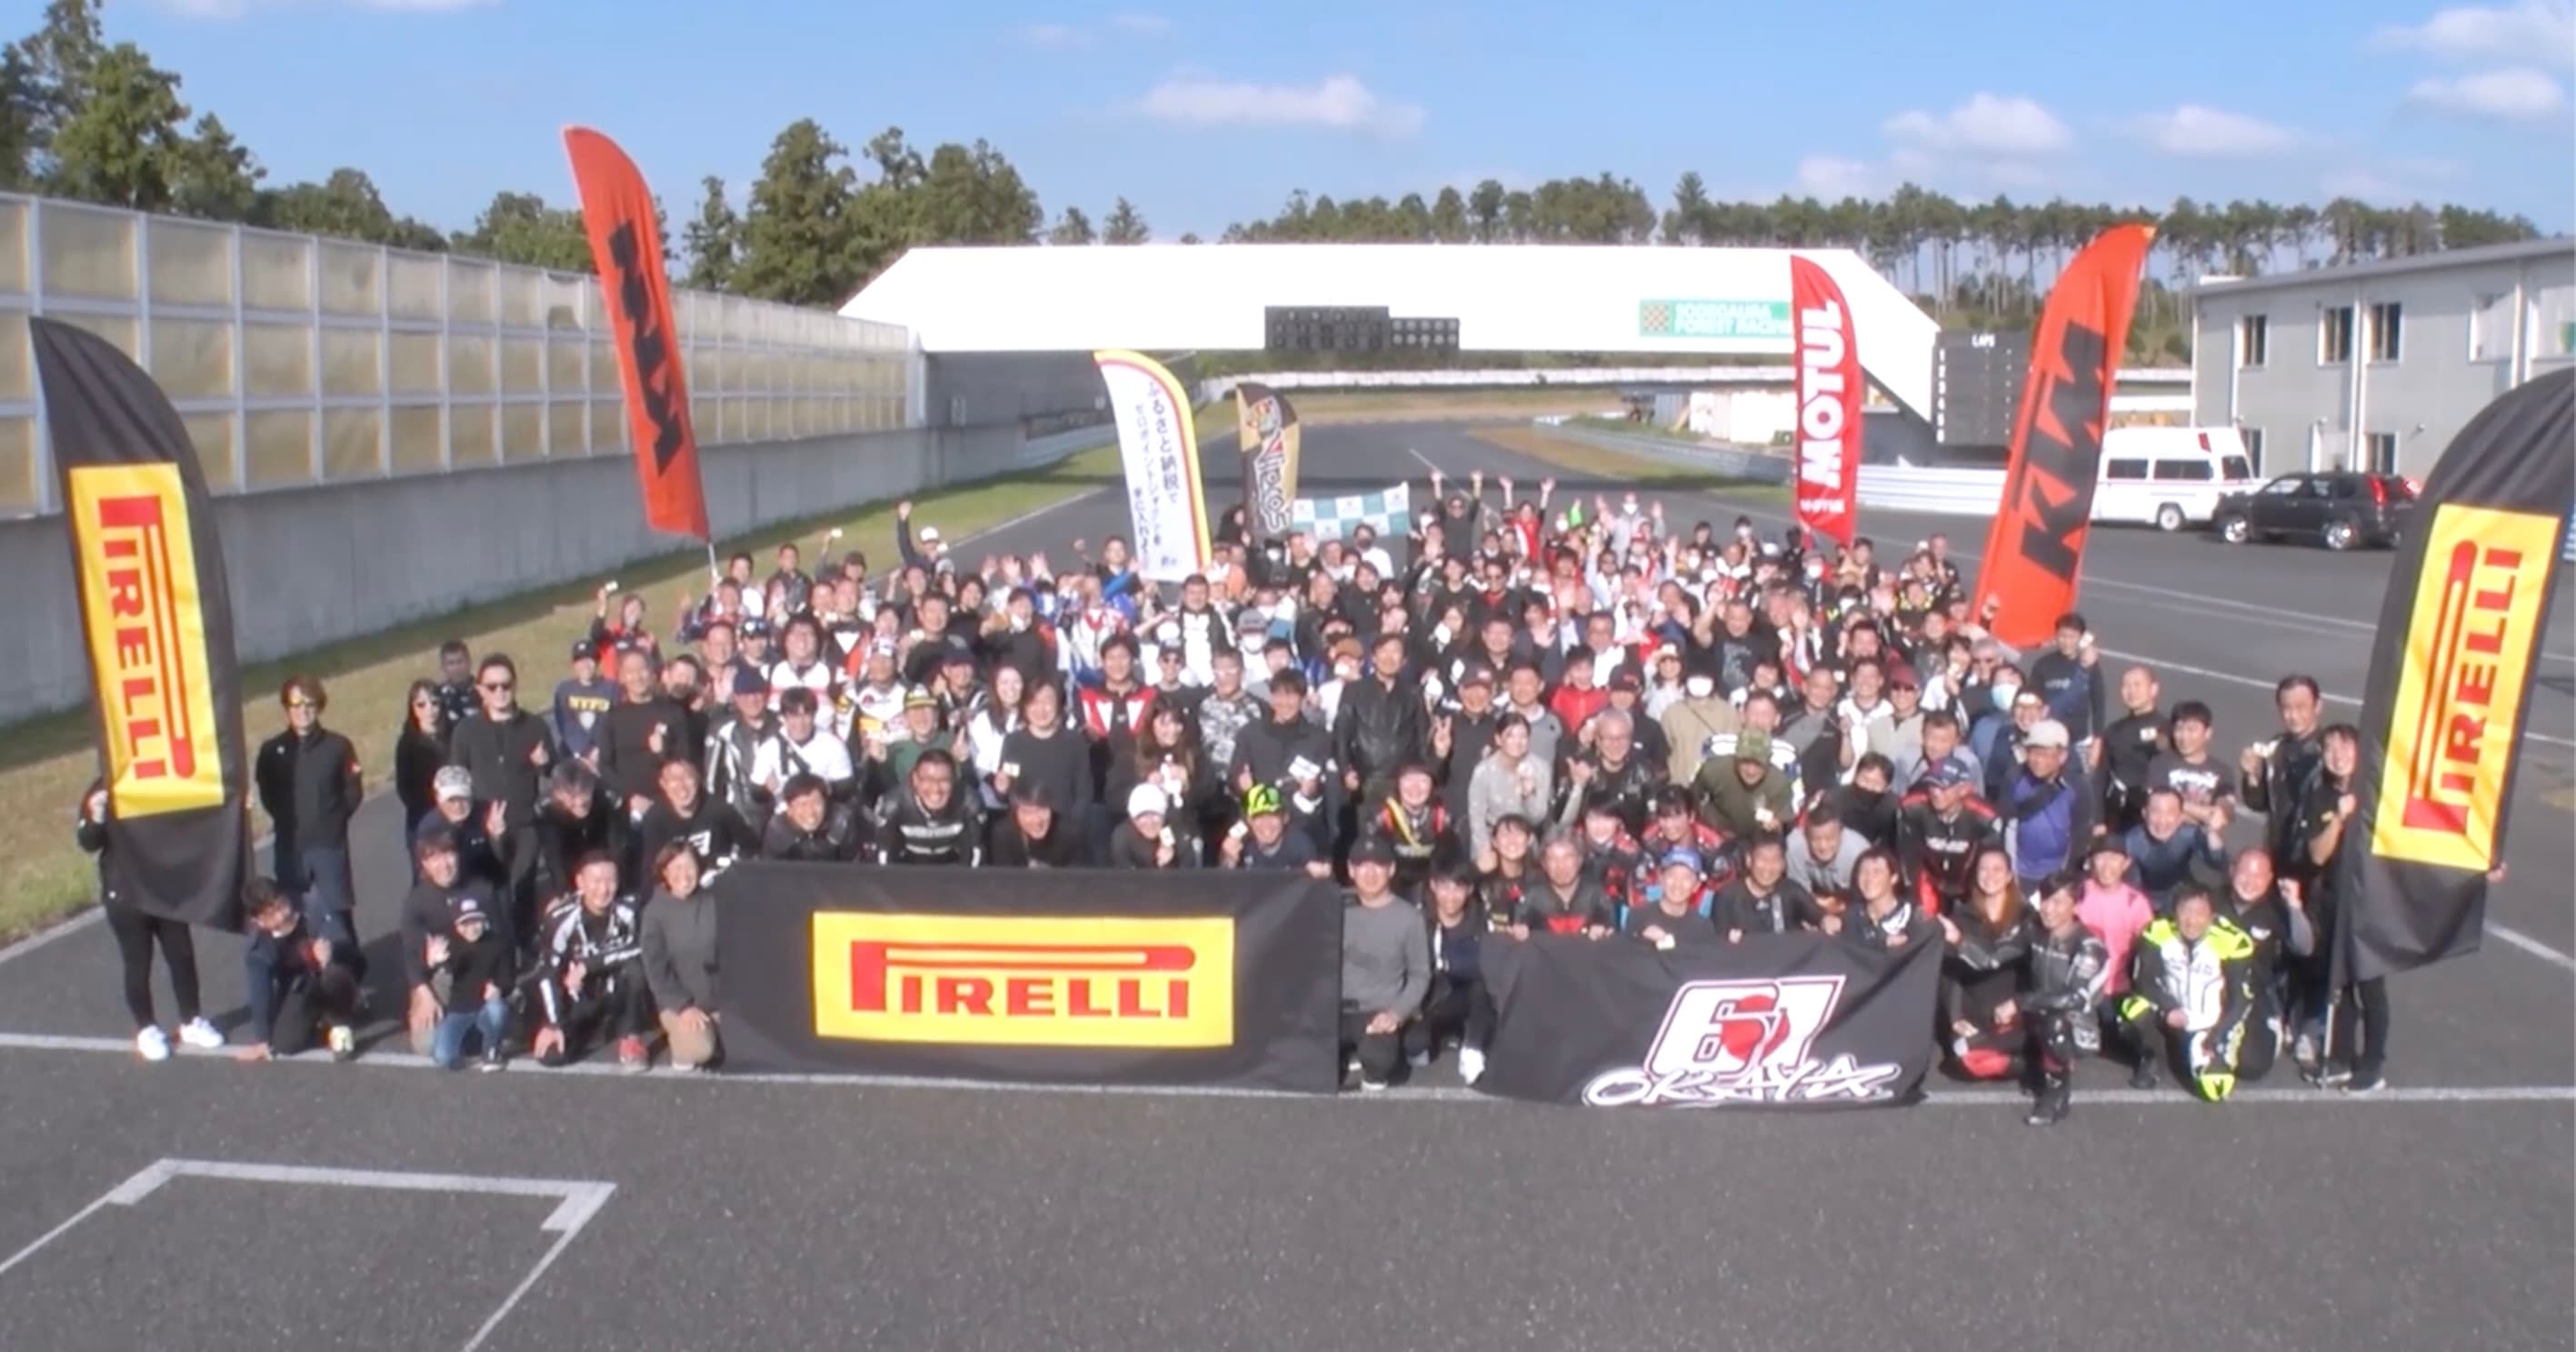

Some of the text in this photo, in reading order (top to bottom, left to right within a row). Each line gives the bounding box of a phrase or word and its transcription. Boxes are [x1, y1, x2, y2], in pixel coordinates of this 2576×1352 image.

[1801, 299, 1845, 488] MOTUL
[98, 496, 195, 779] PIRELLI
[2401, 539, 2522, 835] PIRELLI
[850, 940, 1195, 1019] PIRELLI
[1643, 975, 1846, 1080] 61
